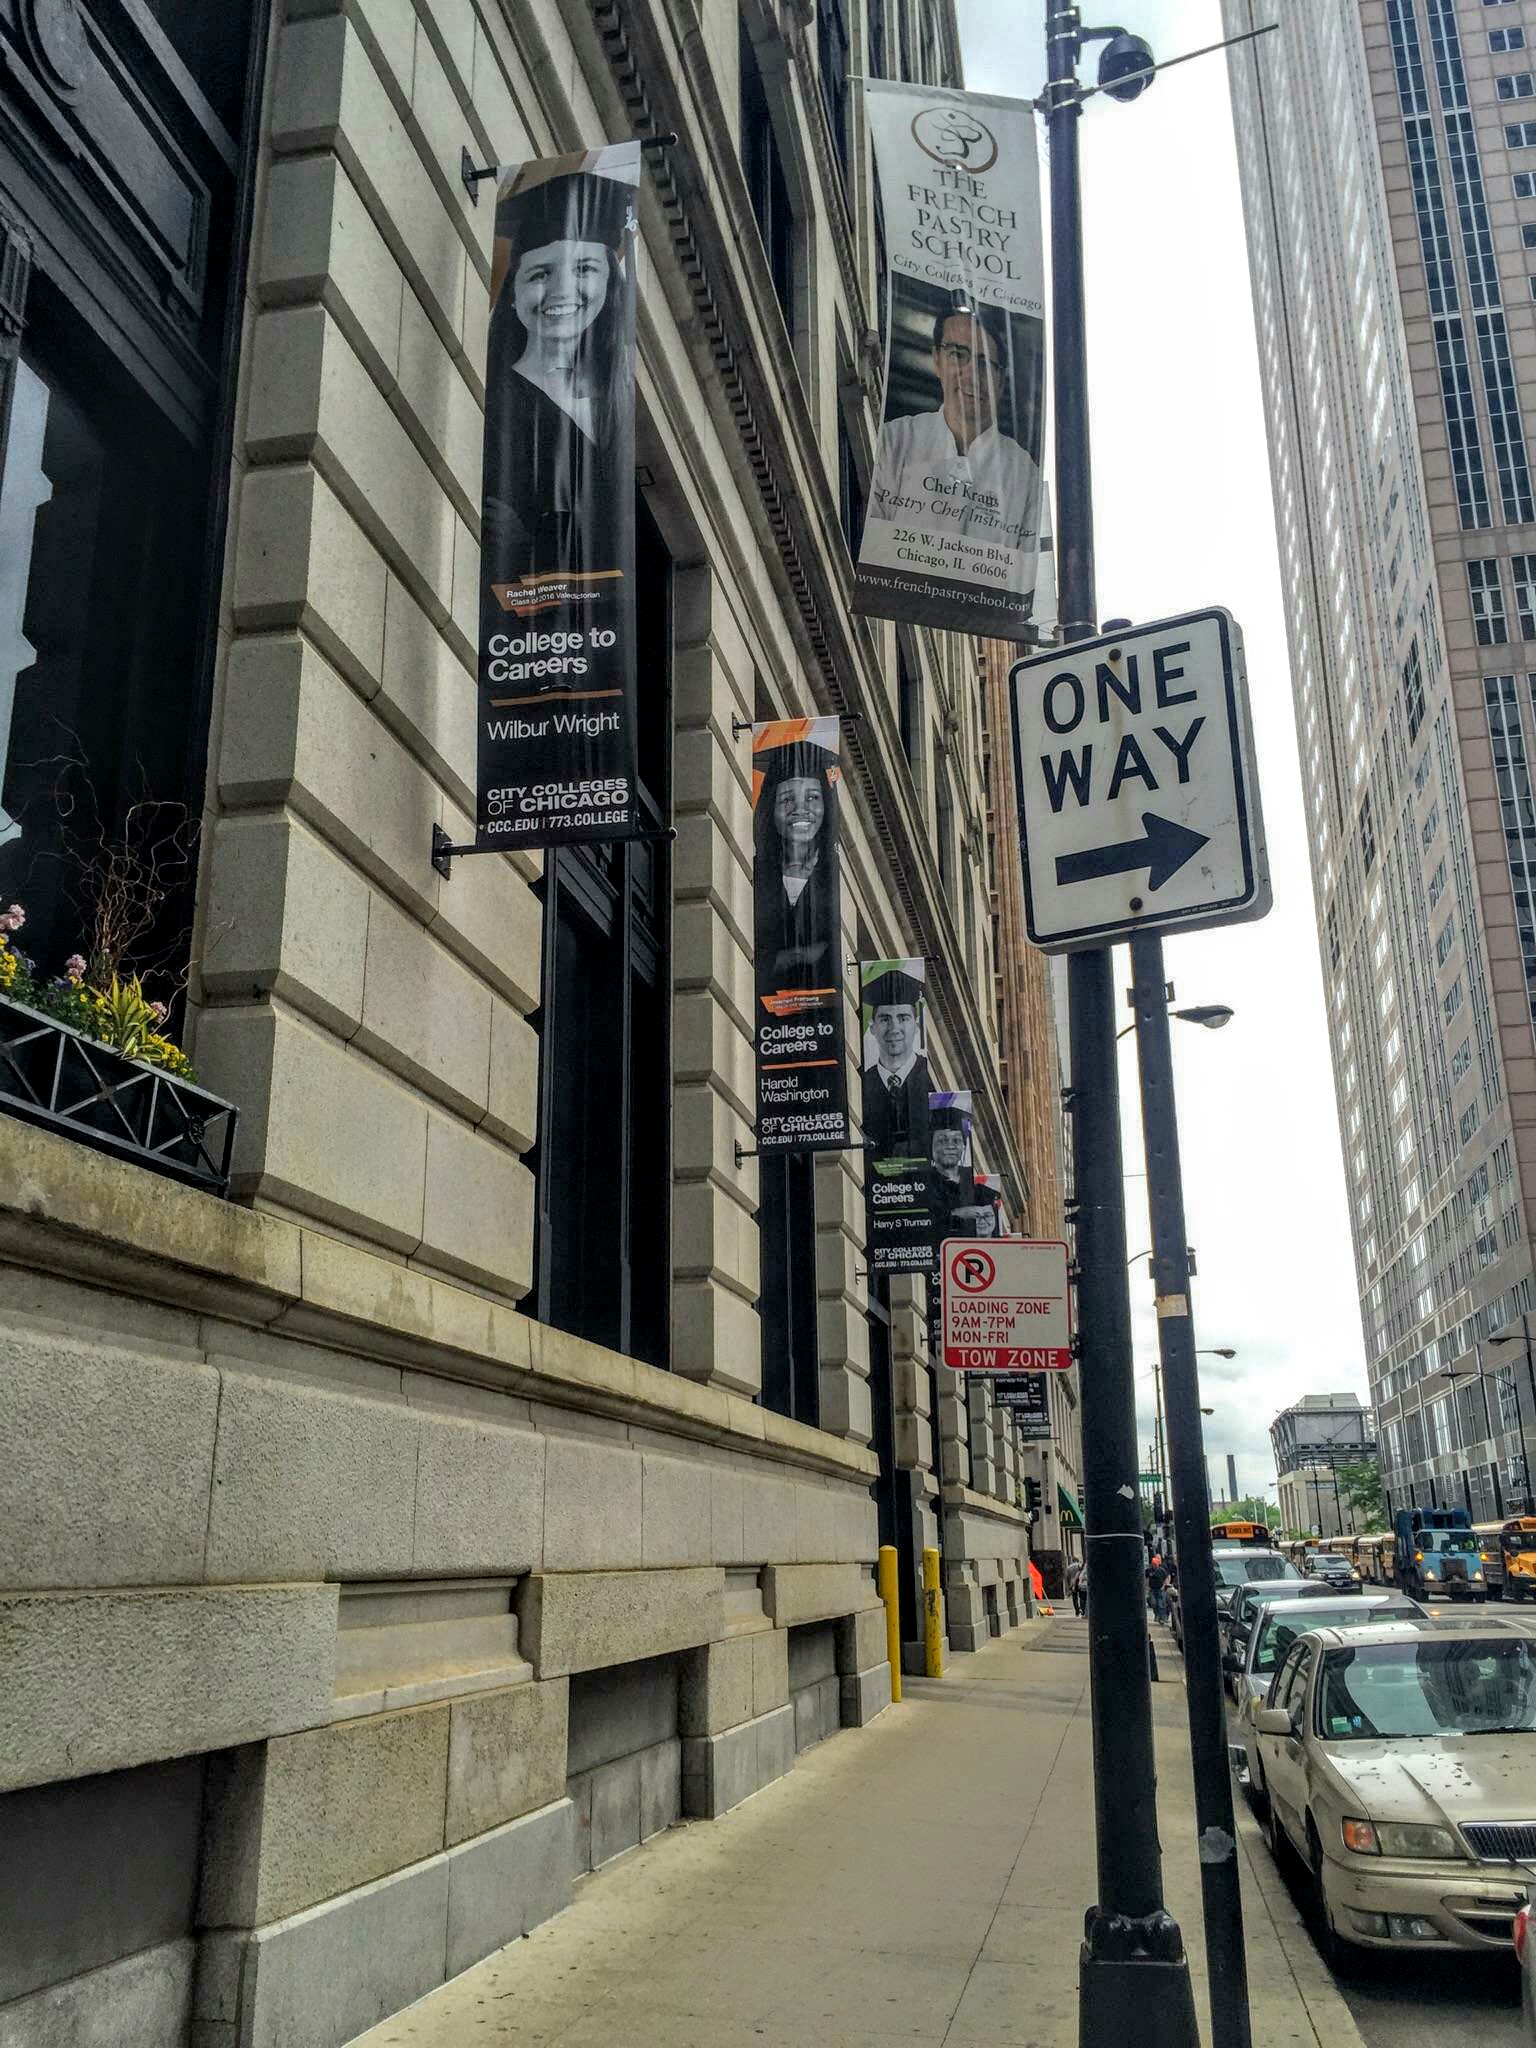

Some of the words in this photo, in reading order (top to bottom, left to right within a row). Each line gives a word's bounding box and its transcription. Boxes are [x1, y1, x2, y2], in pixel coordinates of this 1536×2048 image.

[932, 168, 988, 200] THE
[907, 184, 1018, 230] FRENCH
[917, 208, 1011, 253] PASTRY
[892, 253, 921, 274] City
[911, 230, 1023, 281] SCHOOL
[922, 476, 959, 496] Chef
[879, 487, 926, 514] Pastry
[930, 499, 968, 522] Chef
[893, 528, 916, 544] 226
[920, 533, 935, 548] W.
[937, 537, 984, 557] Jackson
[986, 547, 1014, 566] Blvd.
[896, 547, 950, 569] Chicago,
[953, 558, 966, 570] IL
[972, 561, 1008, 581] 60606
[506, 588, 537, 599] Rachel
[537, 584, 568, 594] Weaver
[511, 598, 530, 607] Class
[488, 631, 584, 657] College
[588, 626, 617, 648] to
[487, 656, 589, 682] Careers
[1042, 641, 1198, 735] ONE
[486, 719, 550, 741] Wilbur
[552, 711, 620, 737] Wright
[1040, 716, 1207, 814] WAY
[487, 786, 528, 801] CITY
[531, 778, 628, 797] COLLEGES
[487, 799, 515, 816] OF
[519, 789, 630, 813] CHICAGO
[487, 817, 539, 834] CCC.EDU
[548, 810, 629, 828] 773.COLLEGE
[760, 1024, 815, 1041] College
[817, 1022, 834, 1036] to
[760, 1040, 819, 1056] Careers
[760, 1075, 799, 1091] Harold
[760, 1087, 830, 1103] Washington
[761, 1115, 786, 1126] CITY
[787, 1112, 844, 1124] COLLEGES
[761, 1124, 778, 1134] OF
[780, 1119, 845, 1133] CHICAGO
[762, 1135, 793, 1145] CCC.EDU
[798, 1130, 845, 1143] 773.COLLEGE
[872, 1182, 912, 1194] College
[914, 1181, 926, 1192] to
[872, 1194, 914, 1205] Careers
[873, 1219, 894, 1230] Harry
[895, 1219, 902, 1228] S
[902, 1218, 932, 1228] Truman
[887, 1250, 934, 1260] CHICAGO
[951, 1301, 1009, 1314] LOADING
[1016, 1302, 1051, 1315] ZONE
[951, 1316, 1016, 1329] 9AM-7PM
[951, 1331, 1009, 1344] MON-FRI
[958, 1349, 997, 1367] TOW
[1007, 1350, 1059, 1367] ZONE
